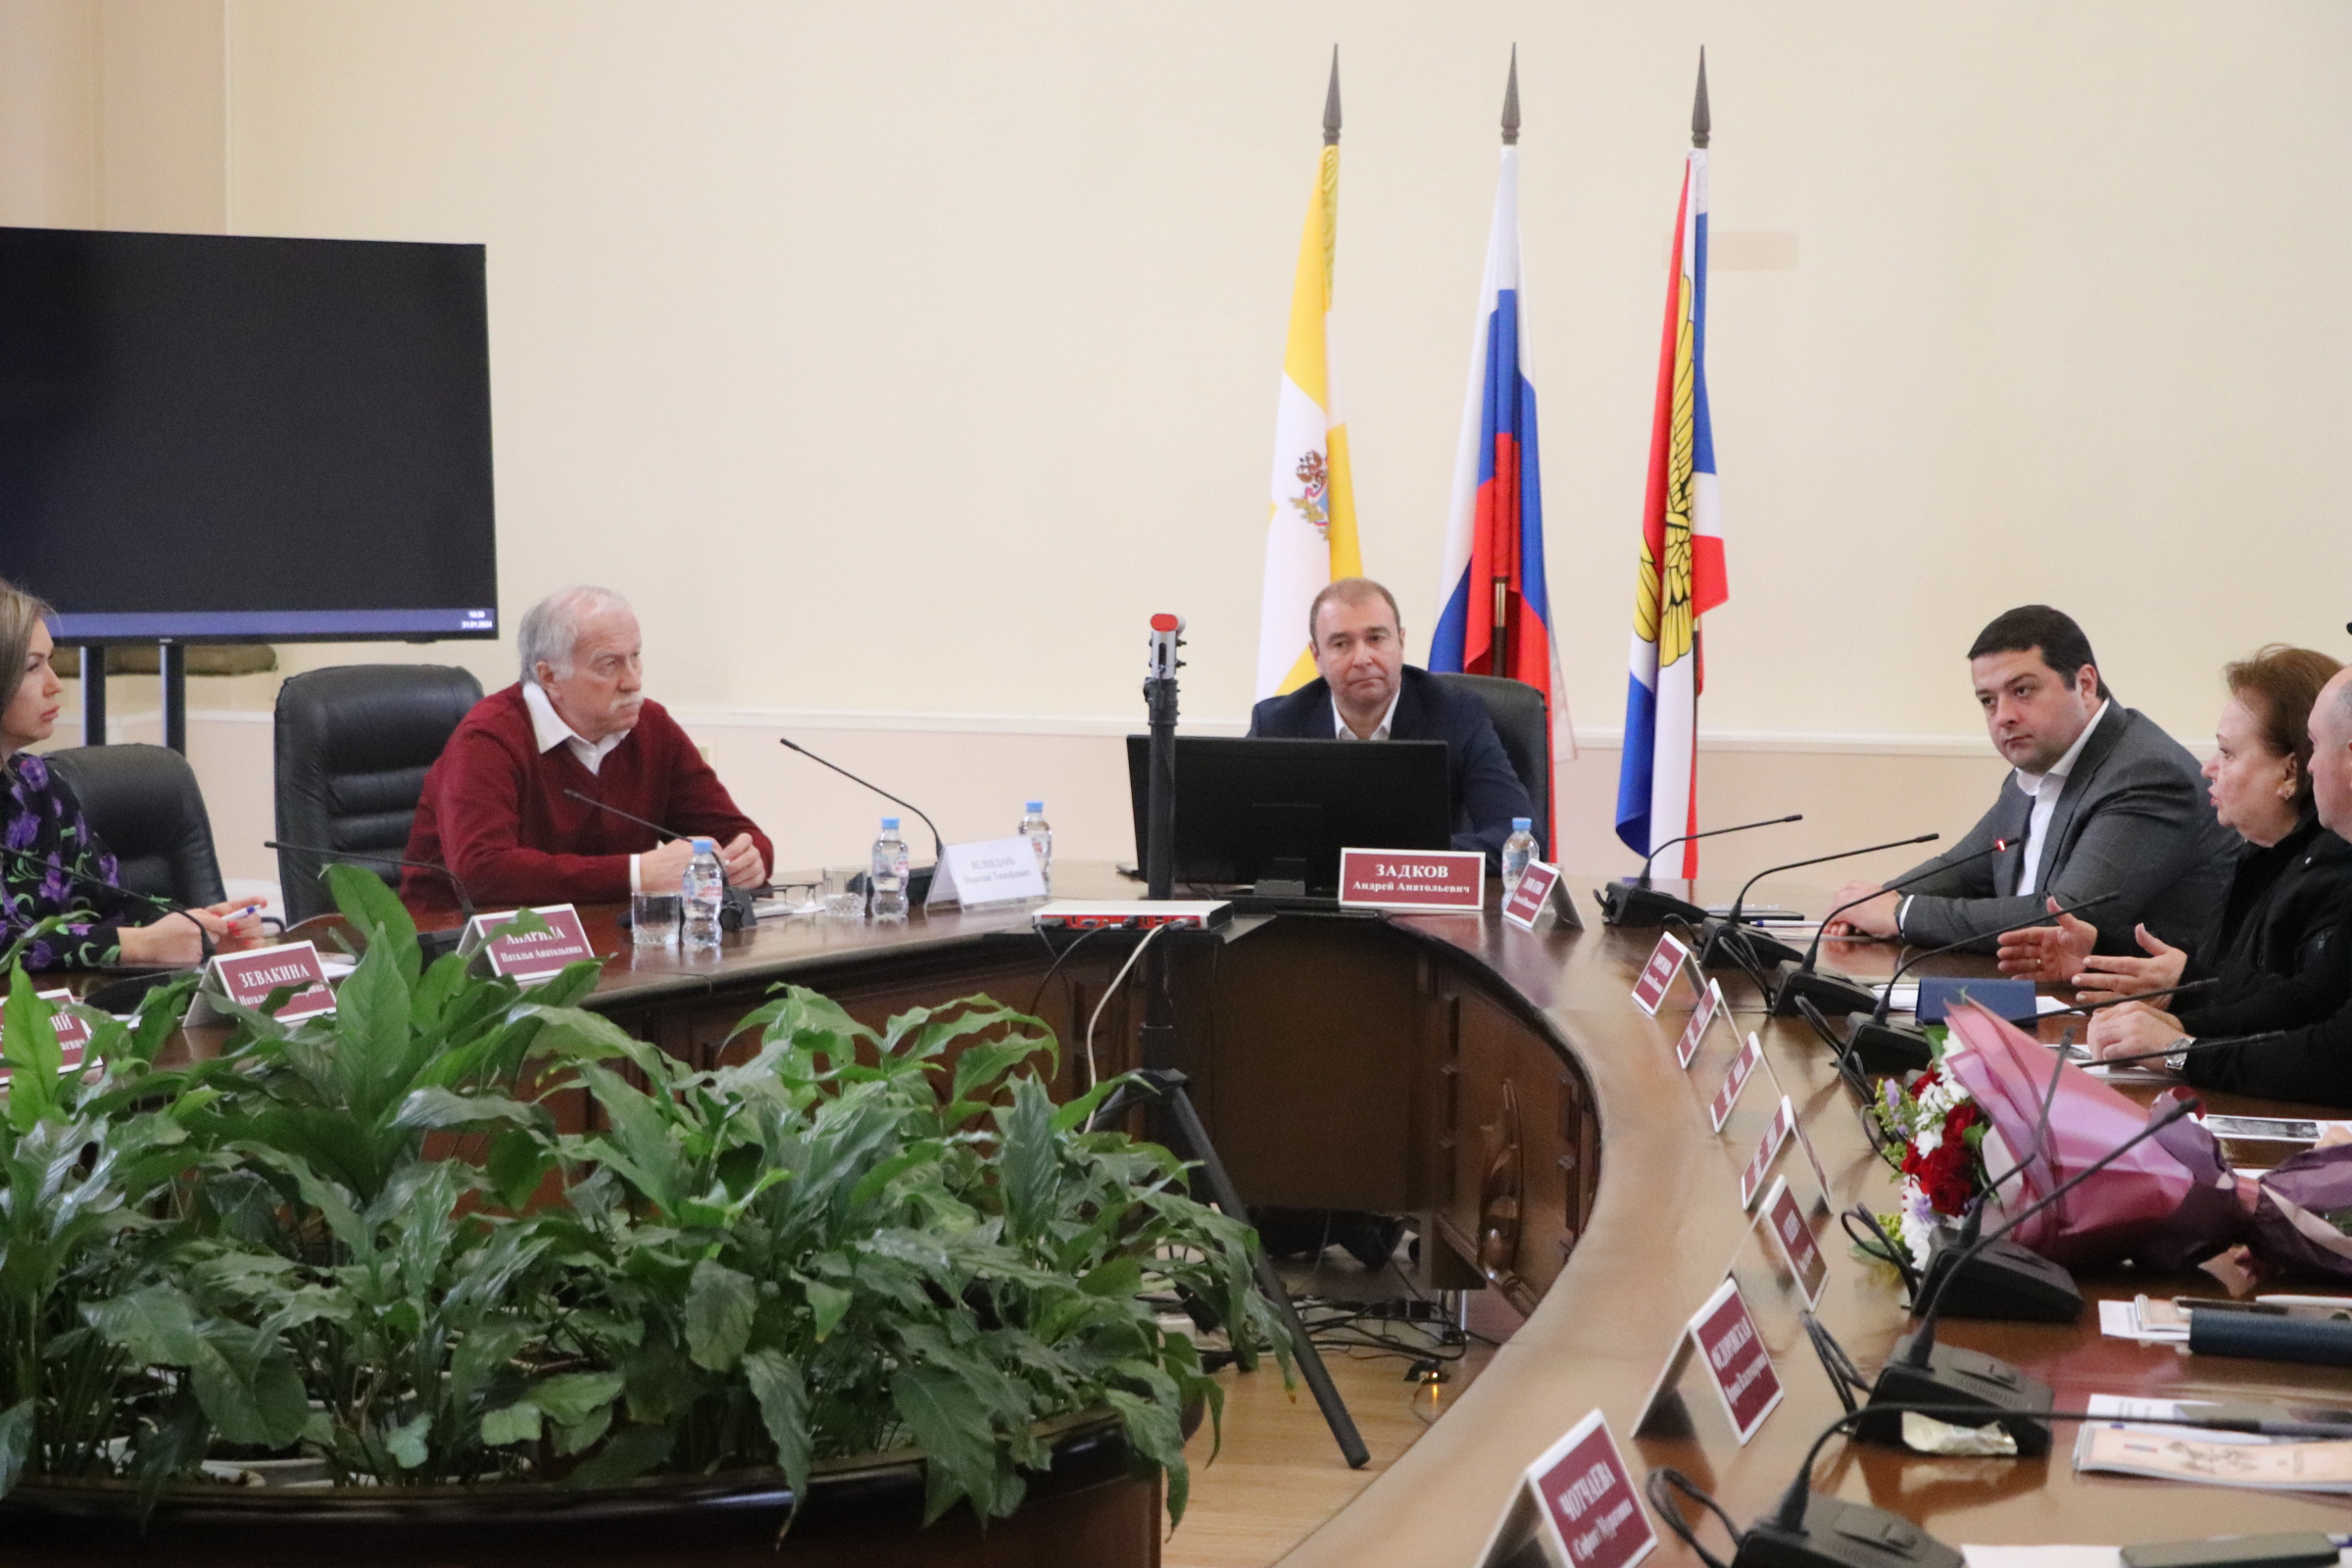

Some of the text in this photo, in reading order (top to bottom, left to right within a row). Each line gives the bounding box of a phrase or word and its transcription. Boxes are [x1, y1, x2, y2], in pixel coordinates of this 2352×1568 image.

[1376, 863, 1449, 879] ЗАДКОВ
[1353, 881, 1470, 894] Андрей Анатольевич
[500, 946, 583, 962] Наталья Анатольевна
[238, 963, 311, 988] ЗЕВАКИНА
[1557, 1459, 1616, 1522] ЧОТЧАЕВА
